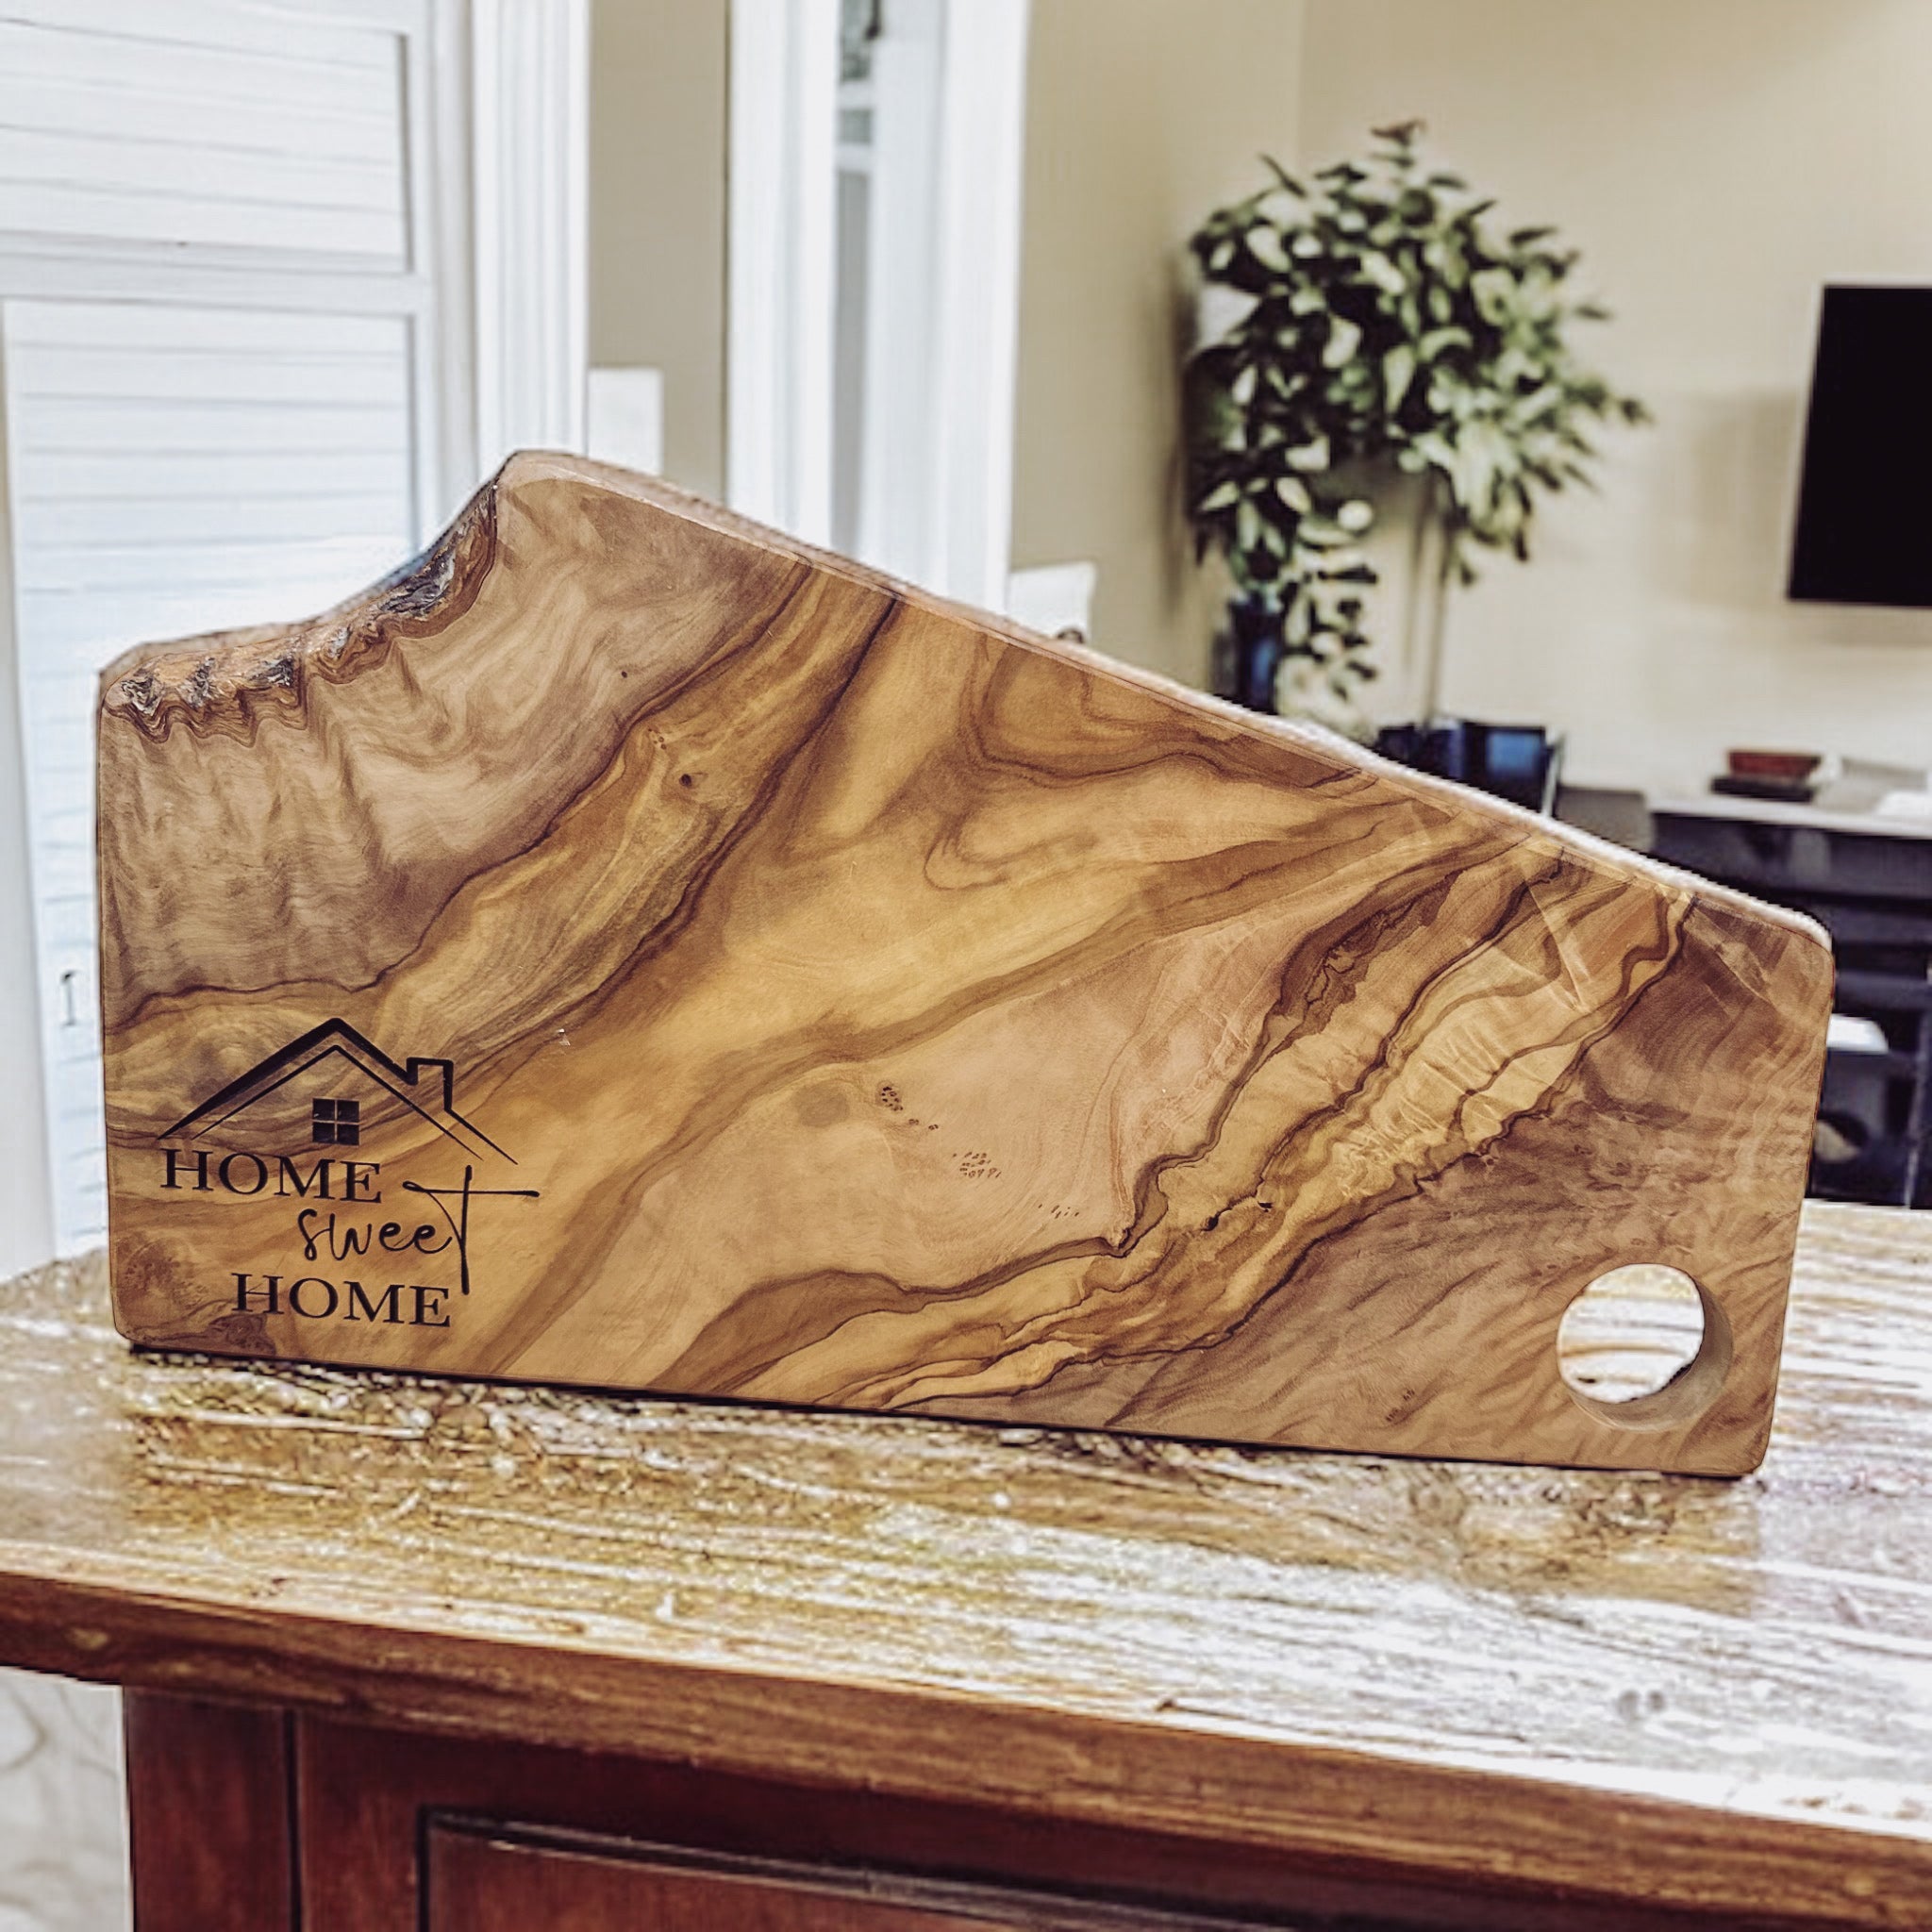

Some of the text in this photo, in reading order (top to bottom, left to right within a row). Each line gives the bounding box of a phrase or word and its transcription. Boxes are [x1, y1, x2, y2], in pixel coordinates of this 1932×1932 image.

[159, 1147, 382, 1204] HOME
[297, 1165, 541, 1295] sweet
[231, 1273, 452, 1328] HOME
